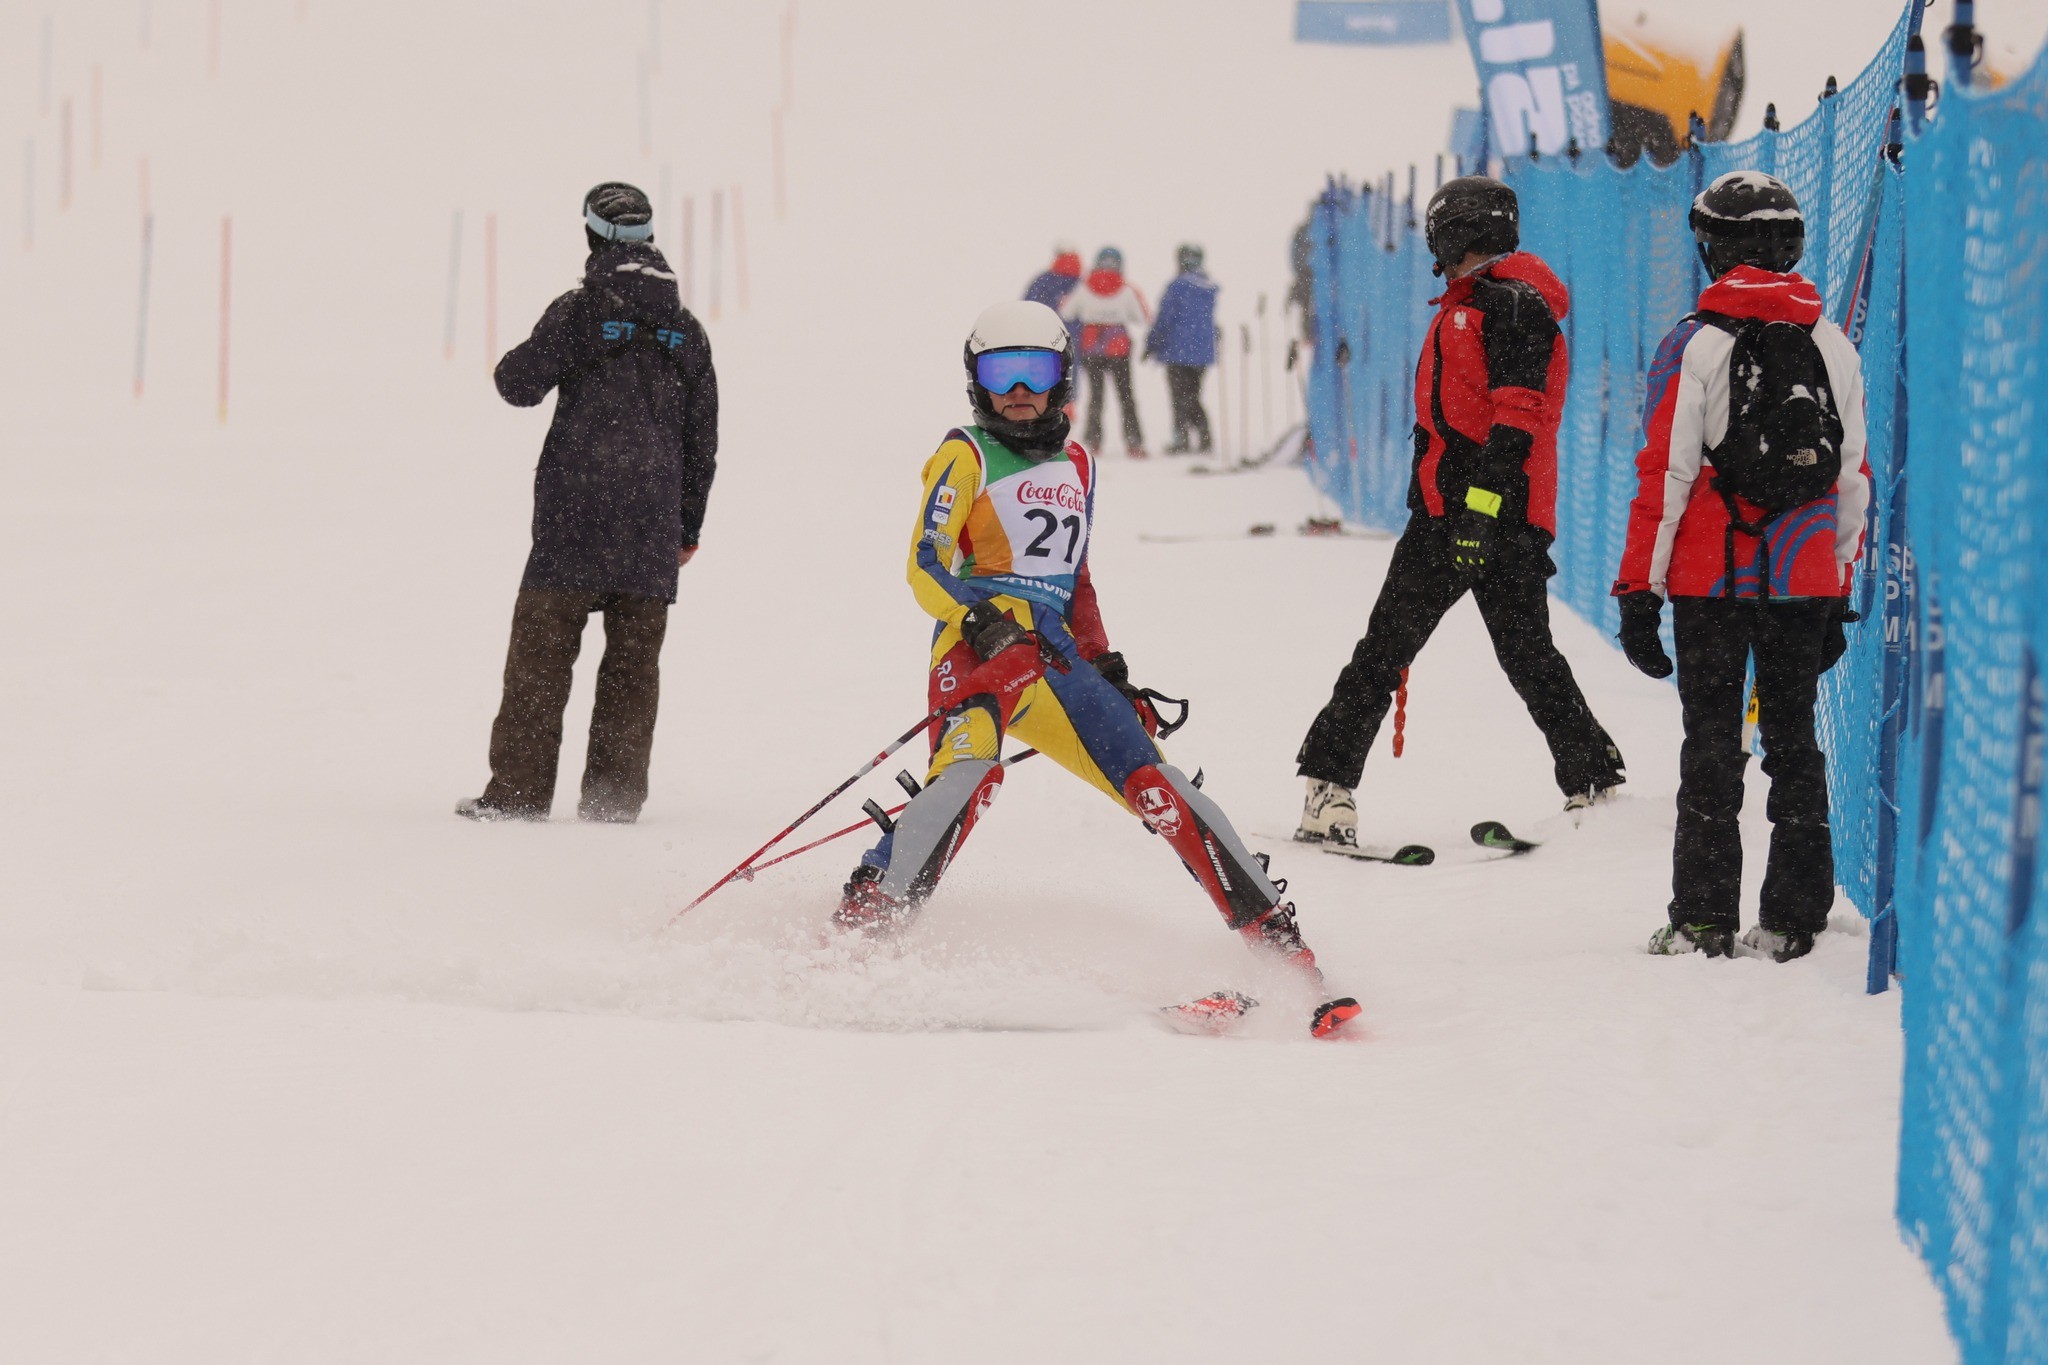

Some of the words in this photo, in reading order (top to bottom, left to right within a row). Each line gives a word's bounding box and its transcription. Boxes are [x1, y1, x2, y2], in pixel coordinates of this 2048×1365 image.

[602, 321, 684, 350] STFF
[1017, 481, 1084, 513] Coca-Cola
[1023, 508, 1080, 565] 21
[1456, 538, 1481, 548] LEKI
[987, 635, 1015, 660] AUCLAIR
[1204, 839, 1233, 892] ENERGIAPURA
